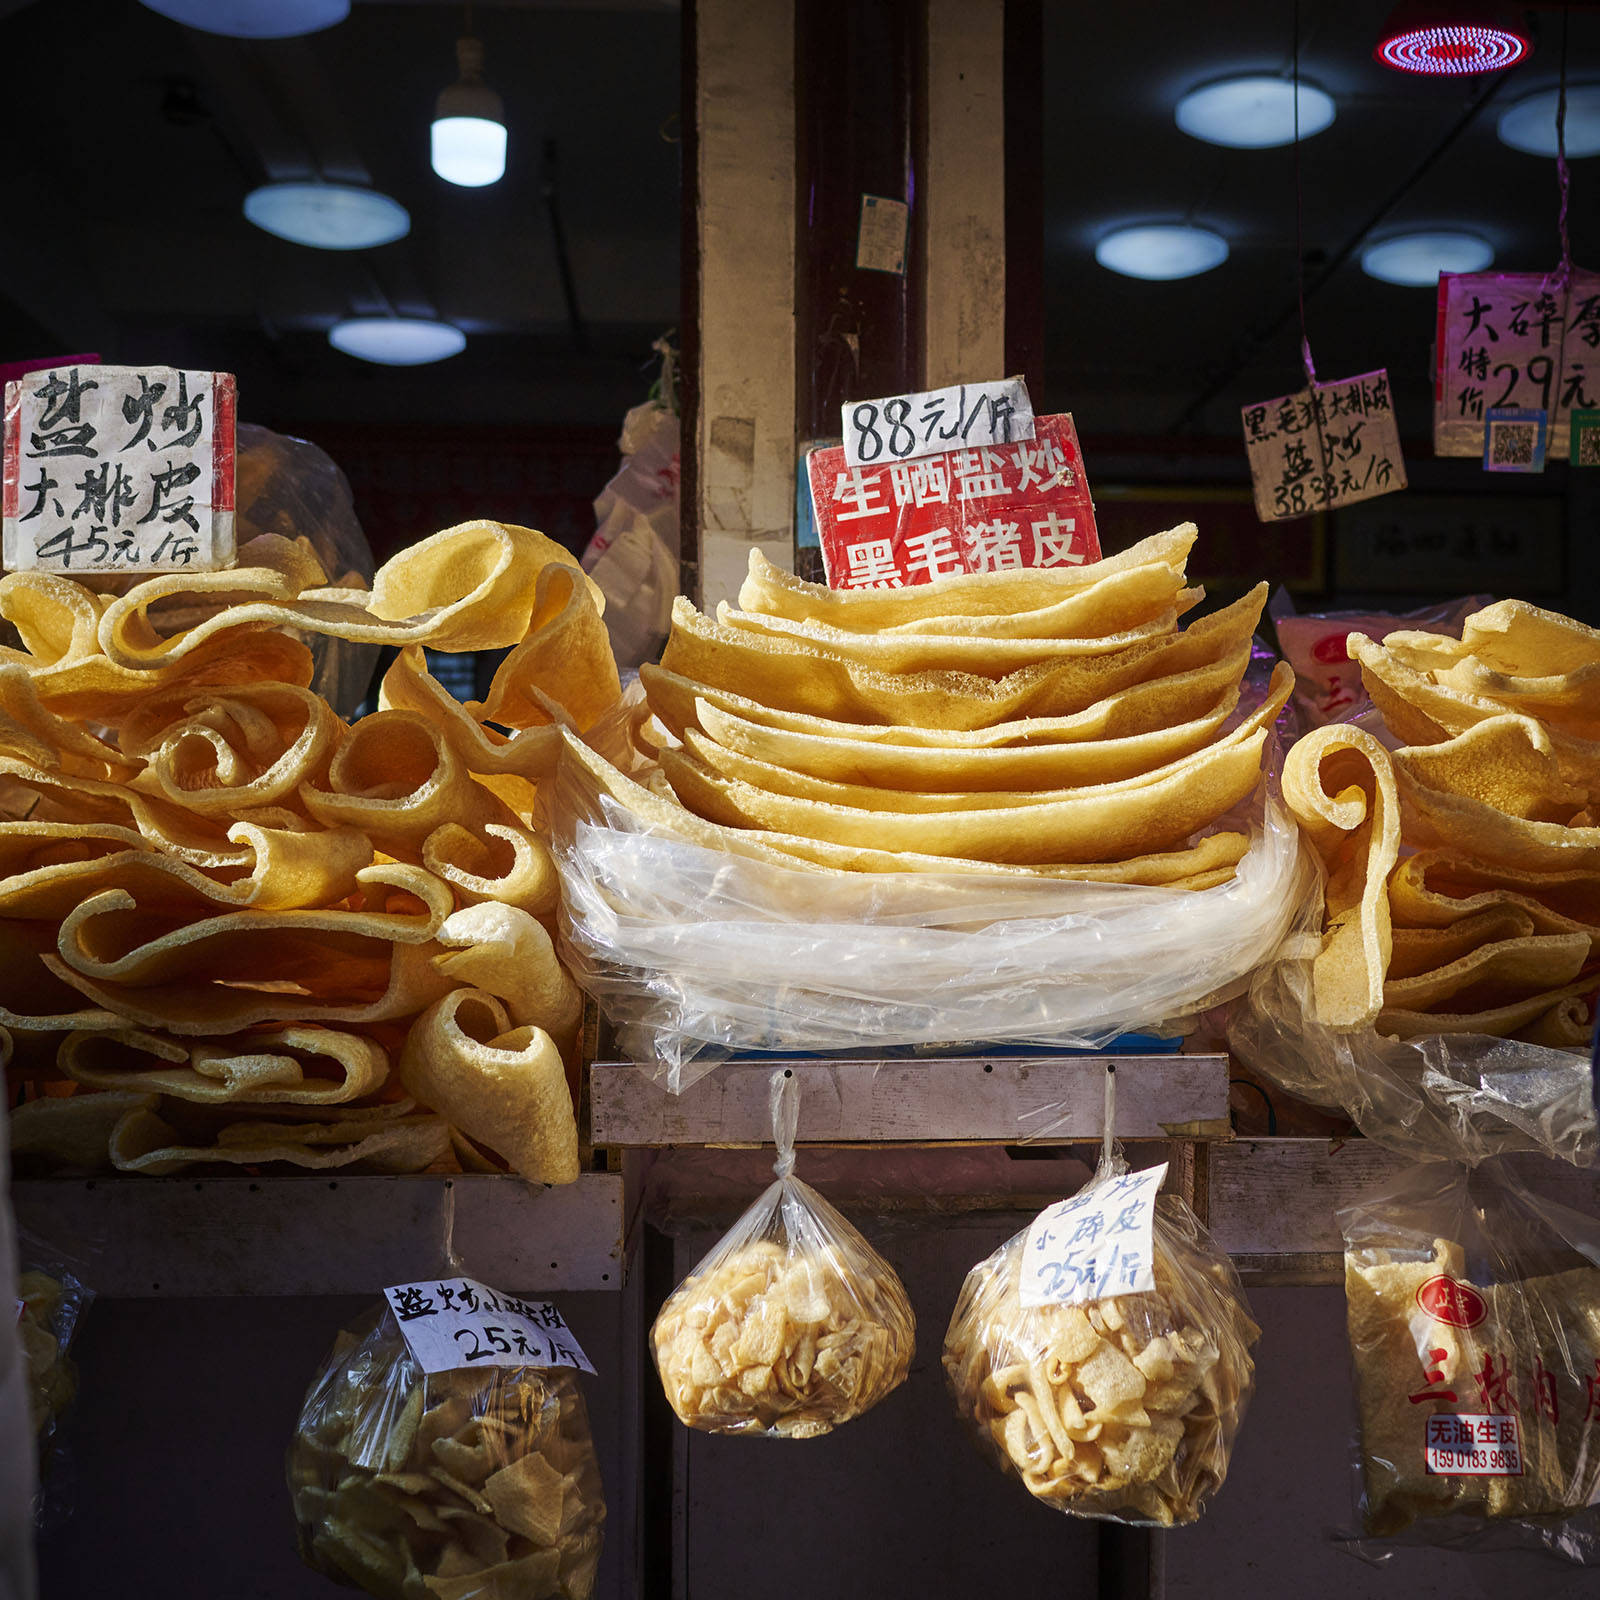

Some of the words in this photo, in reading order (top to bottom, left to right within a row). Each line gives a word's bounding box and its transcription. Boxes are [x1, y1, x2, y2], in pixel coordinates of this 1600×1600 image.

[26, 368, 205, 459] 盐炒
[1458, 346, 1491, 421] 特价
[852, 392, 1016, 462] 88元/斤
[19, 461, 202, 533] 大排皮
[832, 438, 1073, 522] 生晒盐炒
[36, 524, 199, 568] 45元/斤
[846, 512, 1086, 590] 黑毛猪皮
[454, 1326, 581, 1369] 25元/斤
[1431, 1419, 1517, 1446] 无油生皮
[1432, 1450, 1454, 1469] 159
[1457, 1450, 1487, 1468] 0183
[1490, 1450, 1518, 1469] 9835
